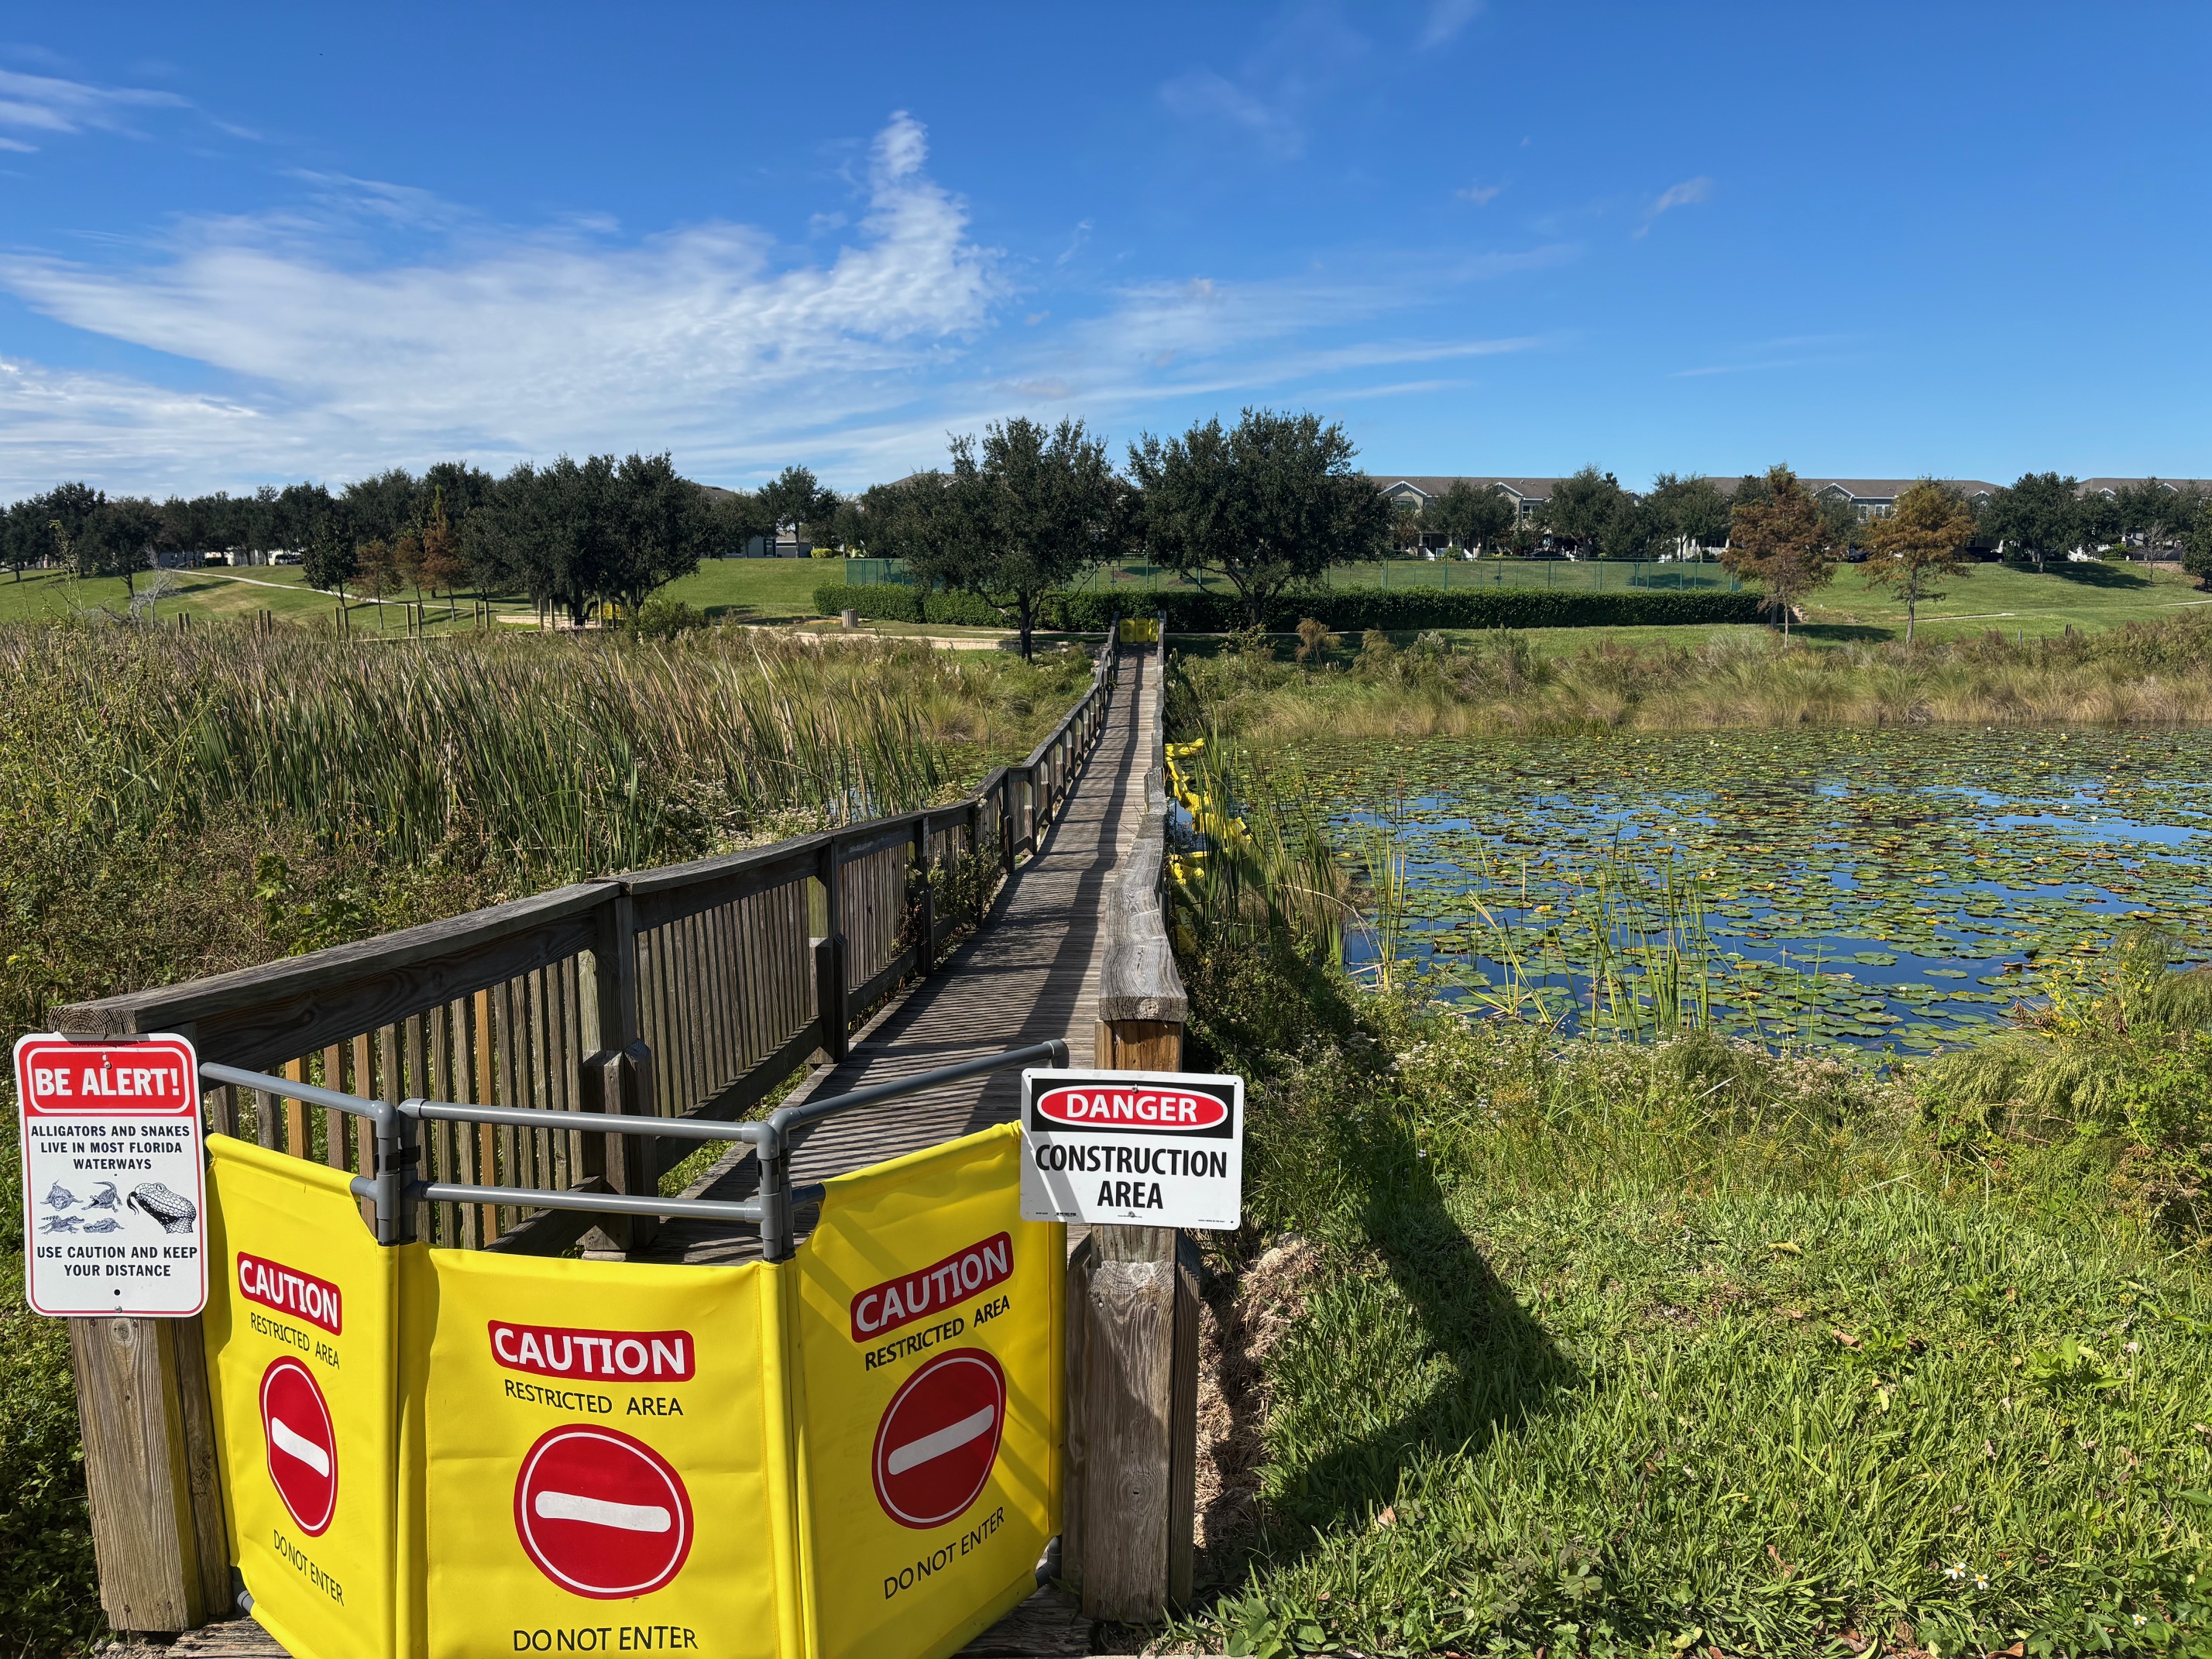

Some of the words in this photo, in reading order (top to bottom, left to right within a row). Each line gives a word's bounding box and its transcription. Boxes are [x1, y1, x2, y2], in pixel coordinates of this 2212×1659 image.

[35, 1068, 72, 1096] BE
[82, 1067, 180, 1096] ALERT!
[1066, 1094, 1197, 1122] DANGER
[31, 1125, 106, 1137] ALLIGATORS
[111, 1125, 136, 1137] AND
[141, 1125, 190, 1137] SNAKES
[40, 1142, 67, 1153] LIVE
[72, 1142, 84, 1153] IN
[90, 1142, 125, 1153] MOST
[129, 1142, 182, 1153] FLORIDA
[1036, 1145, 1227, 1178] CONSTRUCTION
[74, 1159, 152, 1170] WATERWAYS
[1097, 1180, 1163, 1209] AREA
[37, 1247, 63, 1259] USE
[67, 1246, 125, 1259] CAUTION
[131, 1246, 158, 1259] AND
[163, 1247, 198, 1259] KEEP
[64, 1265, 100, 1276] YOUR
[105, 1265, 170, 1276] DISTANCE
[240, 1259, 338, 1328] CAUTION
[856, 1241, 1008, 1332] CAUTION
[250, 1312, 309, 1352] RESTRICTED
[315, 1341, 340, 1370] AREA
[865, 1317, 964, 1371] RESTRICTED
[974, 1295, 1010, 1328] AREA
[494, 1328, 685, 1376] CAUTION
[504, 1379, 613, 1413] RESTRICTED
[626, 1397, 683, 1417] AREA
[273, 1529, 287, 1557] DO
[288, 1542, 307, 1576] NOT
[311, 1561, 344, 1606] ENTER
[884, 1568, 914, 1599] DO
[917, 1542, 957, 1582] NOT
[961, 1506, 1005, 1556] ENTER
[514, 1630, 551, 1651] DO
[557, 1627, 612, 1651] NOT
[619, 1626, 699, 1650] ENTER
